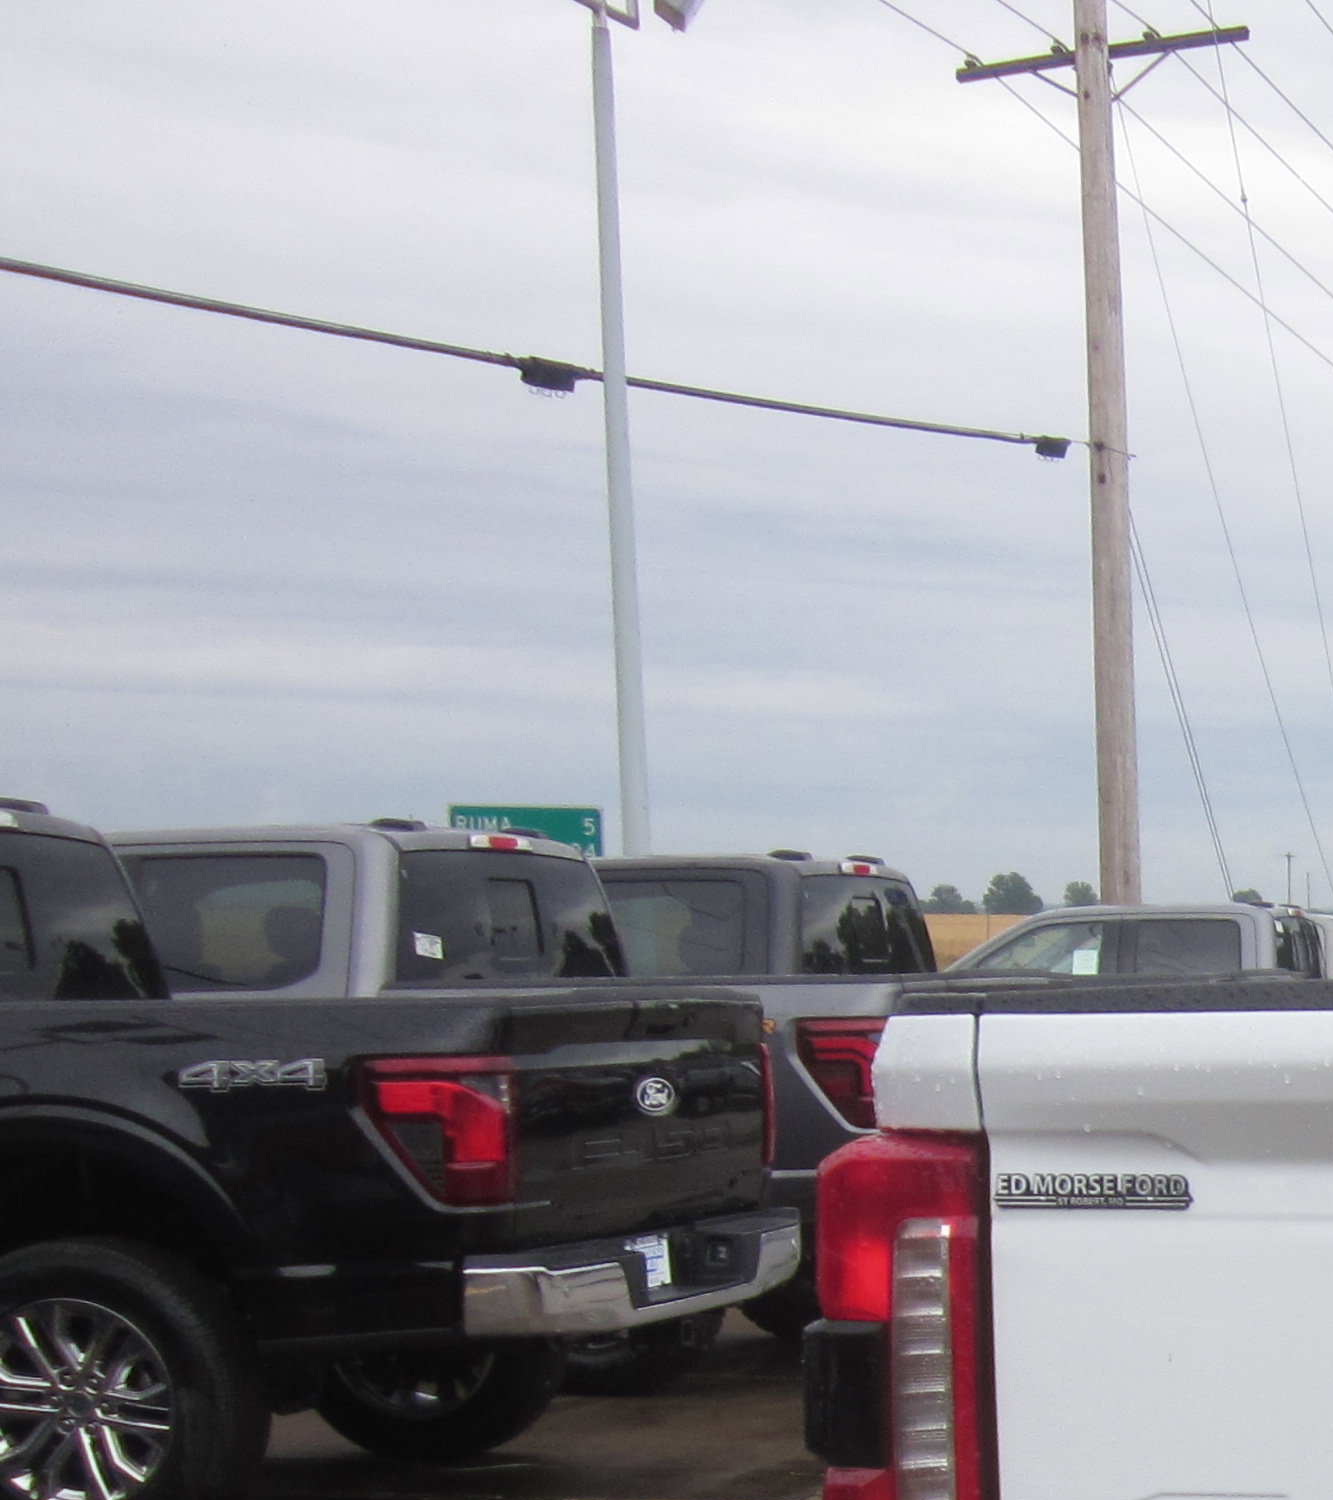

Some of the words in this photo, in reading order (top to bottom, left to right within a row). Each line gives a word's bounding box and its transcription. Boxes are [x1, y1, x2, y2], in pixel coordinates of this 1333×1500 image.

[455, 814, 512, 830] RUMA
[583, 817, 596, 836] 5
[997, 1173, 1027, 1195] ED
[1032, 1173, 1115, 1195] MORSE
[1119, 1173, 1187, 1196] FORD
